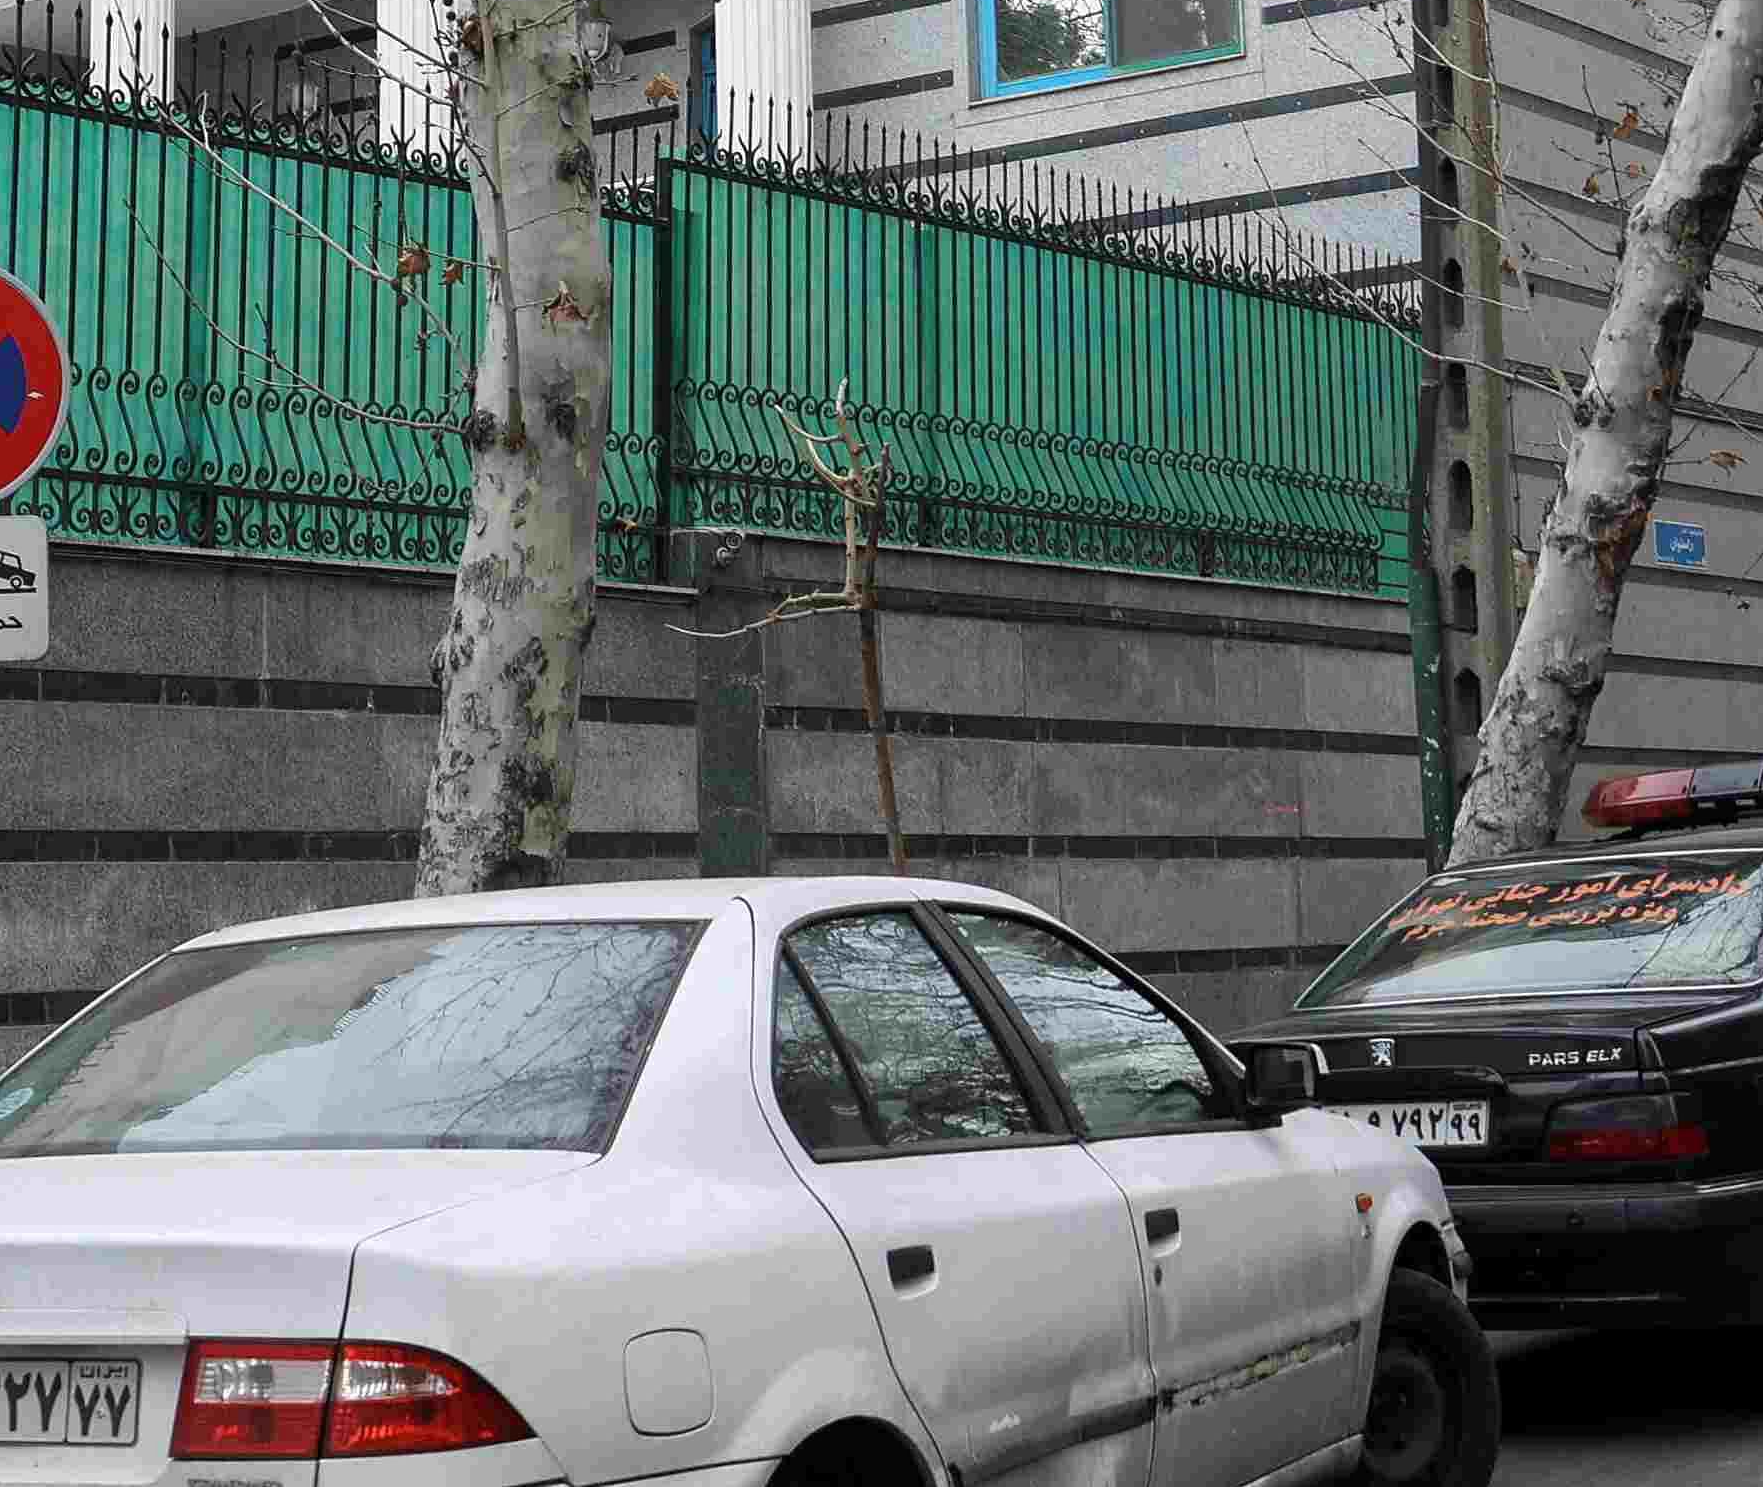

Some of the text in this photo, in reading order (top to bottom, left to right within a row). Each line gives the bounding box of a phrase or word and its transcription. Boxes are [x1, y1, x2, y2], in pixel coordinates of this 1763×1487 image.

[1461, 882, 1550, 914] جنایی
[1547, 873, 1622, 904] امور
[1616, 871, 1752, 900] دادسرای
[1528, 904, 1616, 929] بررسی
[1620, 901, 1679, 925] ویژه
[1528, 1047, 1623, 1066] PARS ELX
[1450, 1112, 1482, 1141] ۹۹
[78, 1364, 130, 1379] ایران
[73, 1383, 131, 1438] ۷۷
